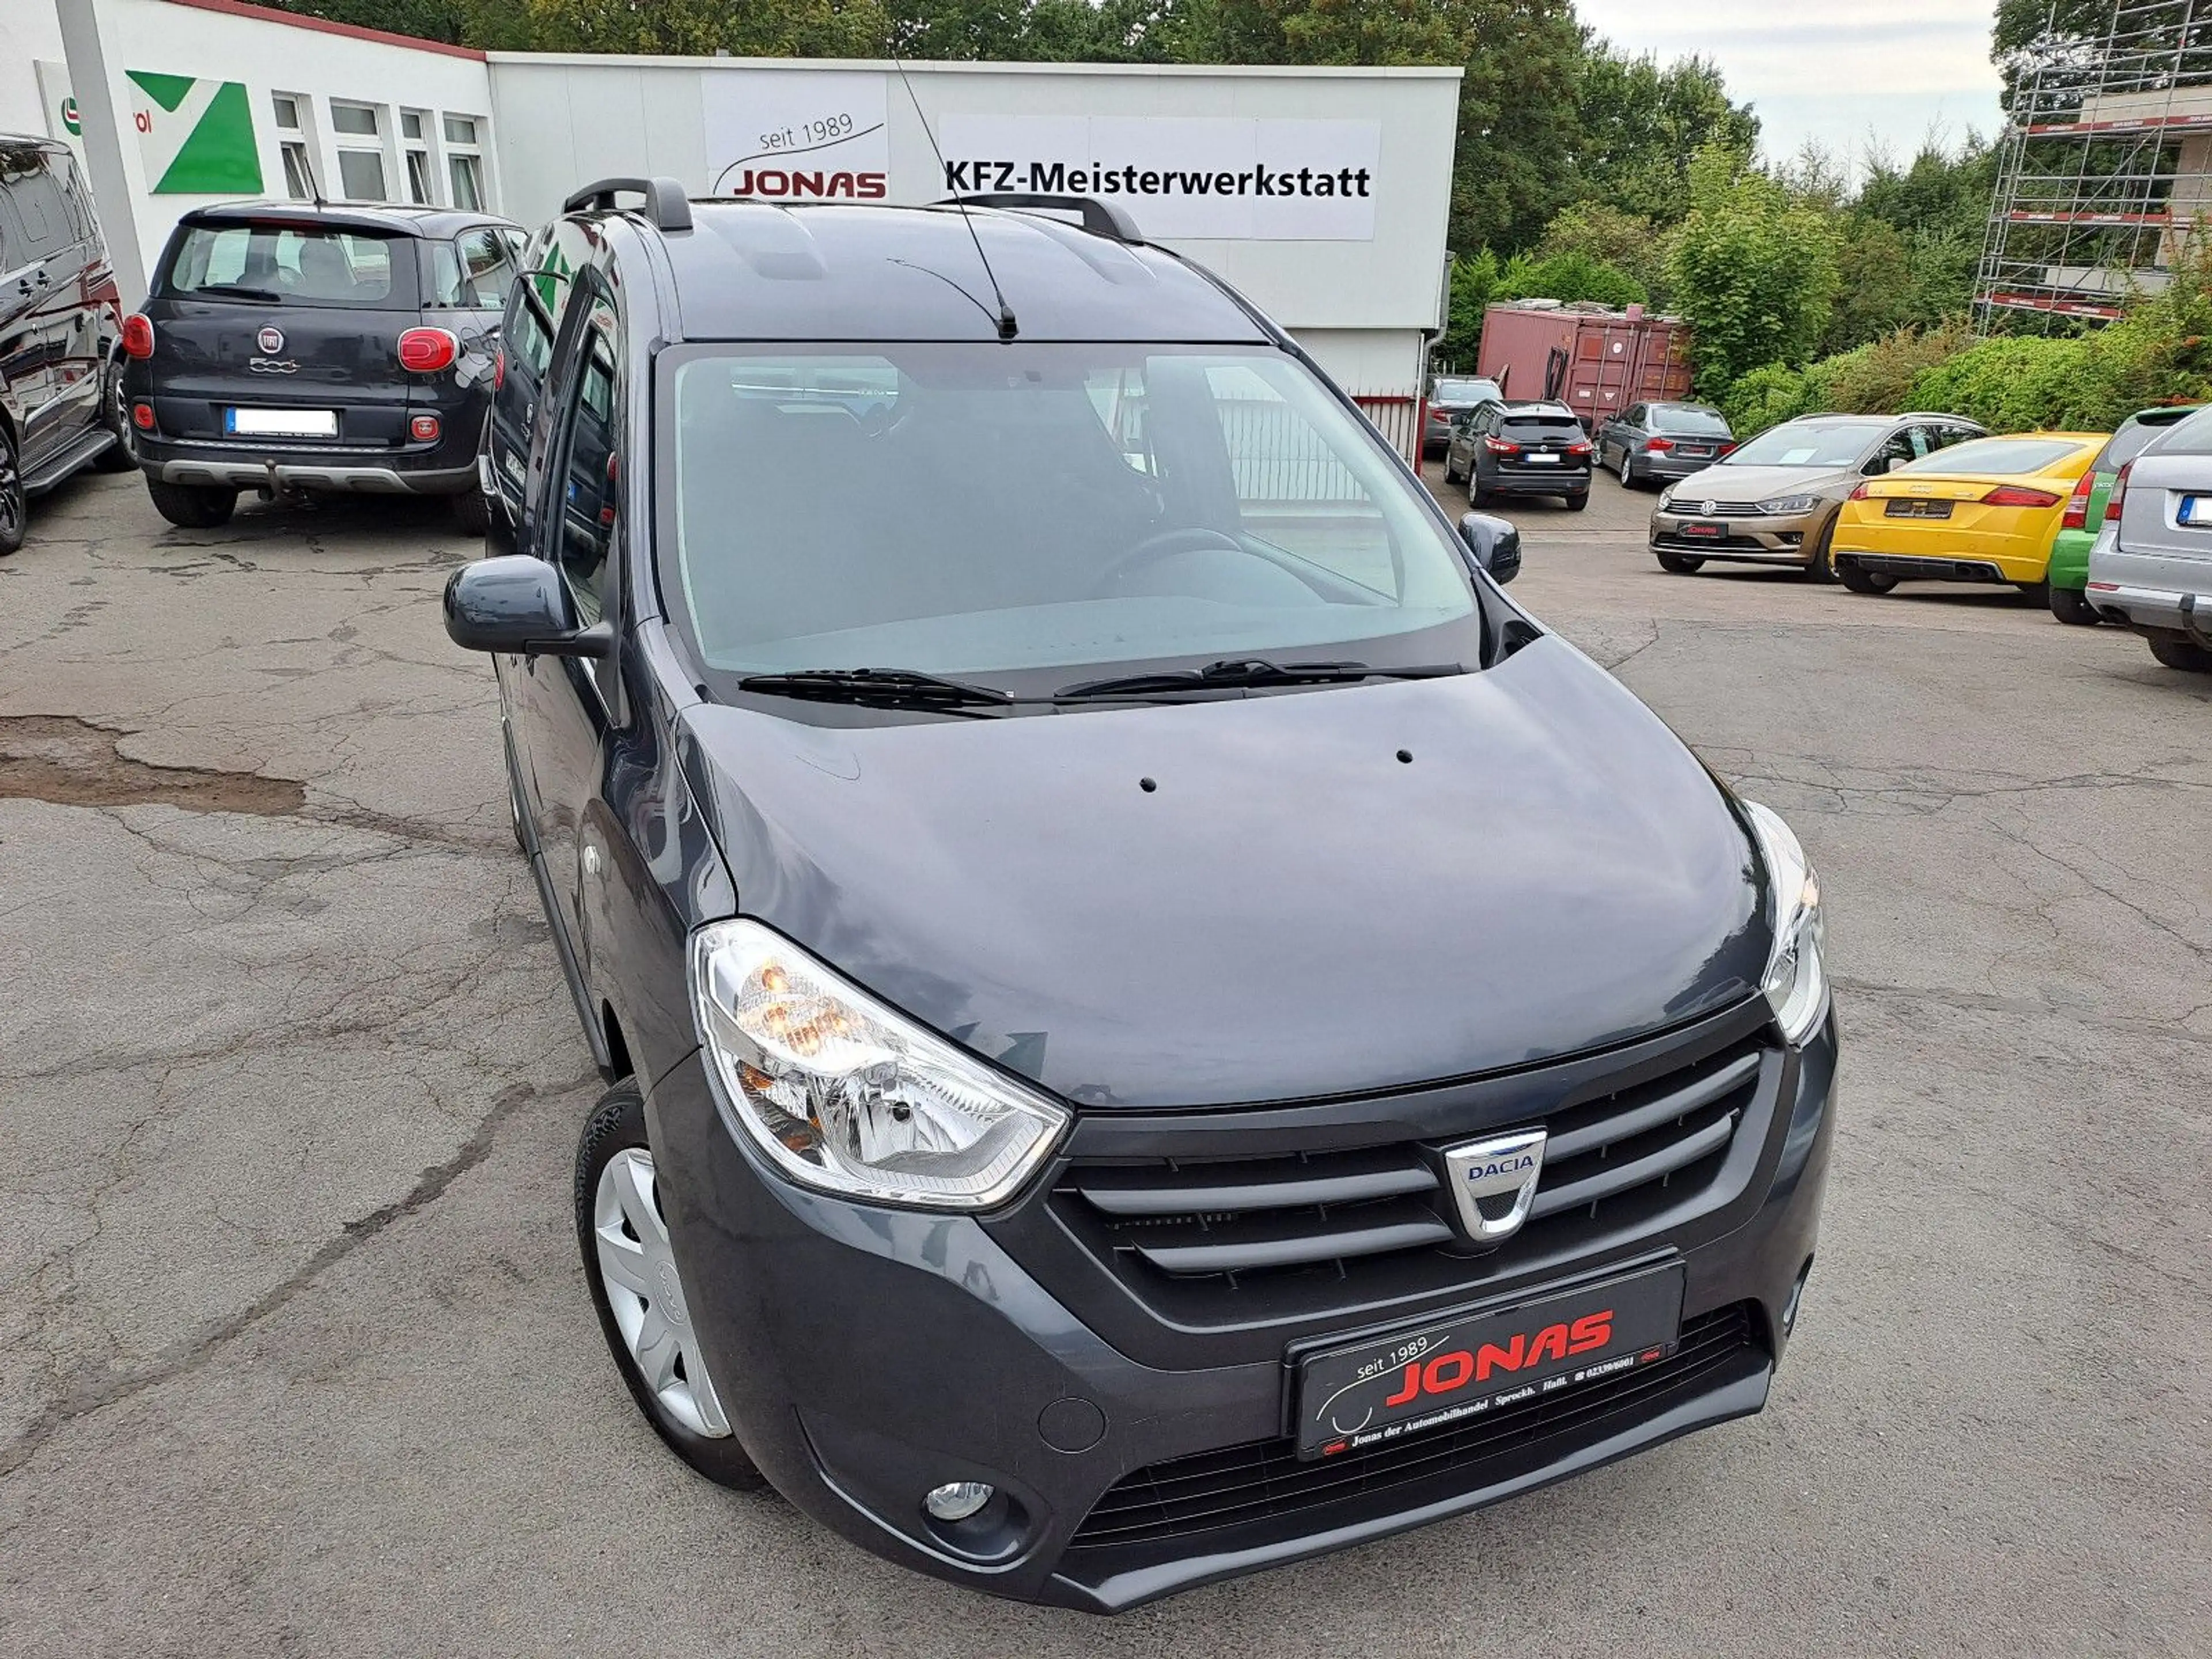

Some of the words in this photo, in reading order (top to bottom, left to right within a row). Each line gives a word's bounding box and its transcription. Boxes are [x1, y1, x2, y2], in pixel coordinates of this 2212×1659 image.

[760, 127, 796, 150] seit
[802, 113, 853, 143] 1989
[733, 169, 887, 199] JONAS
[946, 160, 1370, 198] KFZ-Meisterwerkstatt
[1468, 1155, 1534, 1180] DACIA
[1357, 1358, 1385, 1380] seit
[1389, 1336, 1428, 1365] 1989
[1386, 1310, 1613, 1407] JONAS
[1352, 1431, 1382, 1447] Jonas
[1384, 1426, 1402, 1438] der
[1404, 1399, 1489, 1432] Automobilhandel
[1495, 1387, 1536, 1406] Sprockh.
